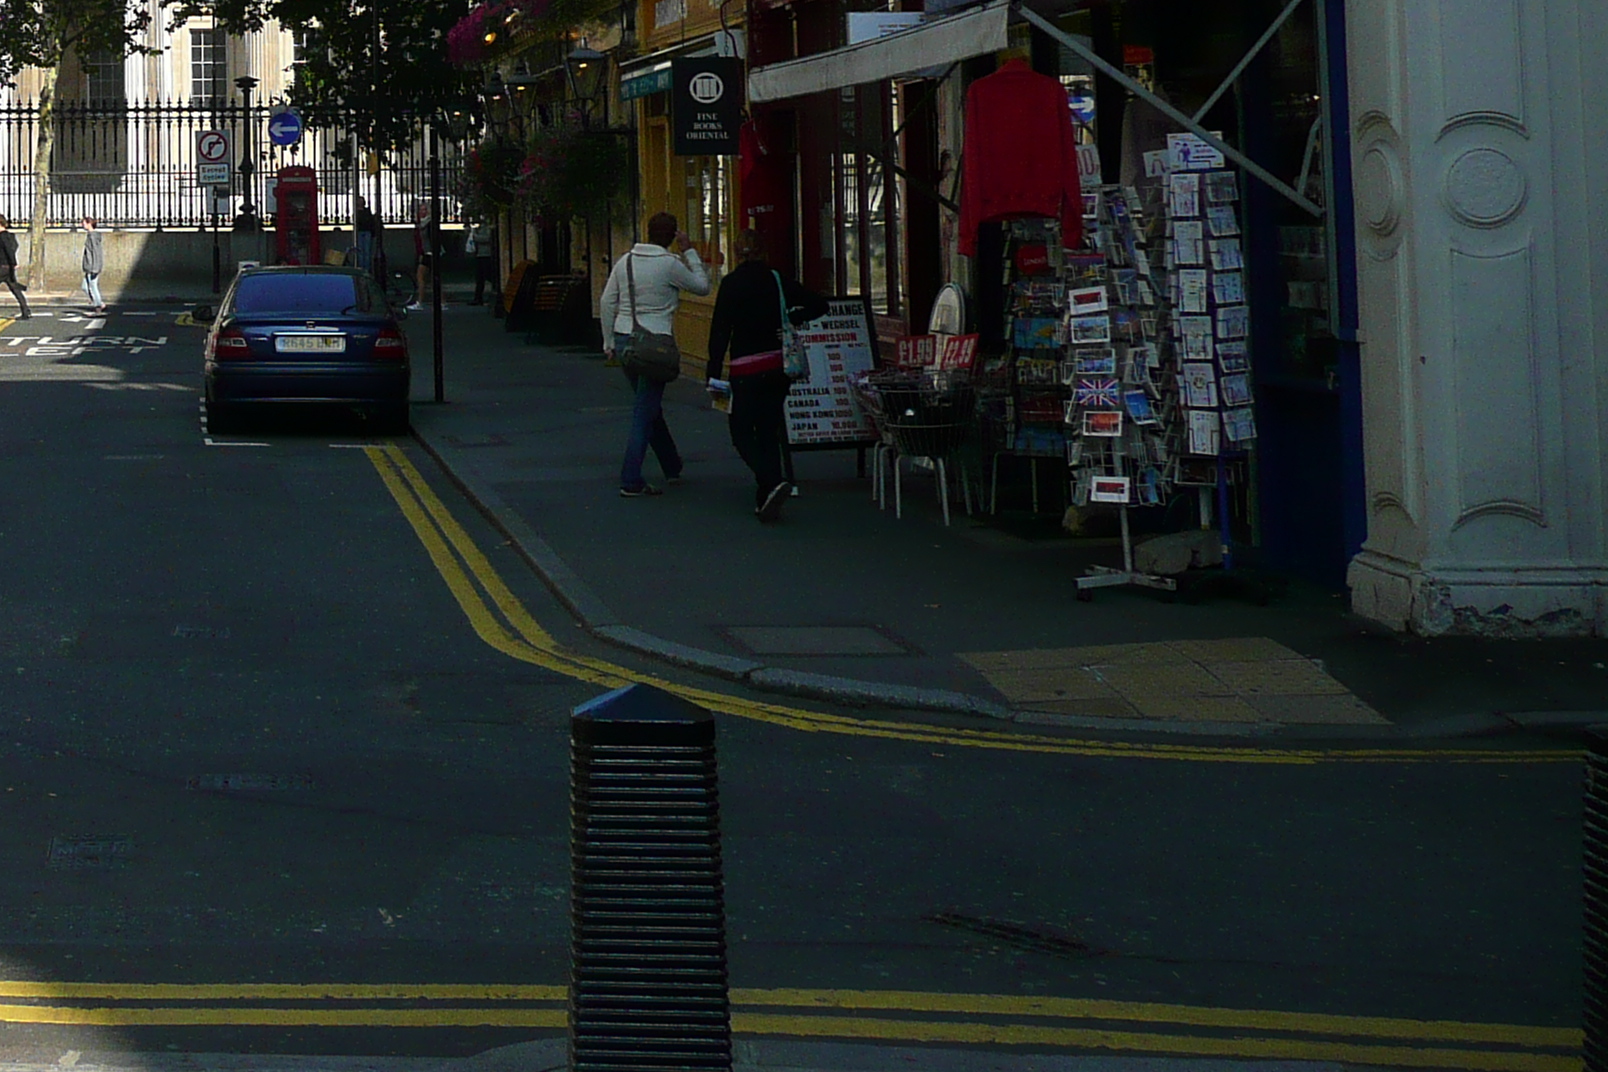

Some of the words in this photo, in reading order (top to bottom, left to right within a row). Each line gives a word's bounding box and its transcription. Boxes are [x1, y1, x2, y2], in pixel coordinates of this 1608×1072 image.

[696, 112, 719, 121] FINE
[693, 121, 723, 130] BOOKS
[685, 131, 730, 140] ORIENTAL
[821, 319, 860, 330] WECHSEL
[0, 336, 168, 346] TURN
[799, 332, 857, 344] COMMISSION
[898, 338, 933, 365] £1.99
[787, 399, 820, 407] CANADA
[789, 411, 811, 419] HONG
[813, 410, 834, 419] KONG
[792, 422, 818, 430] JAPAN
